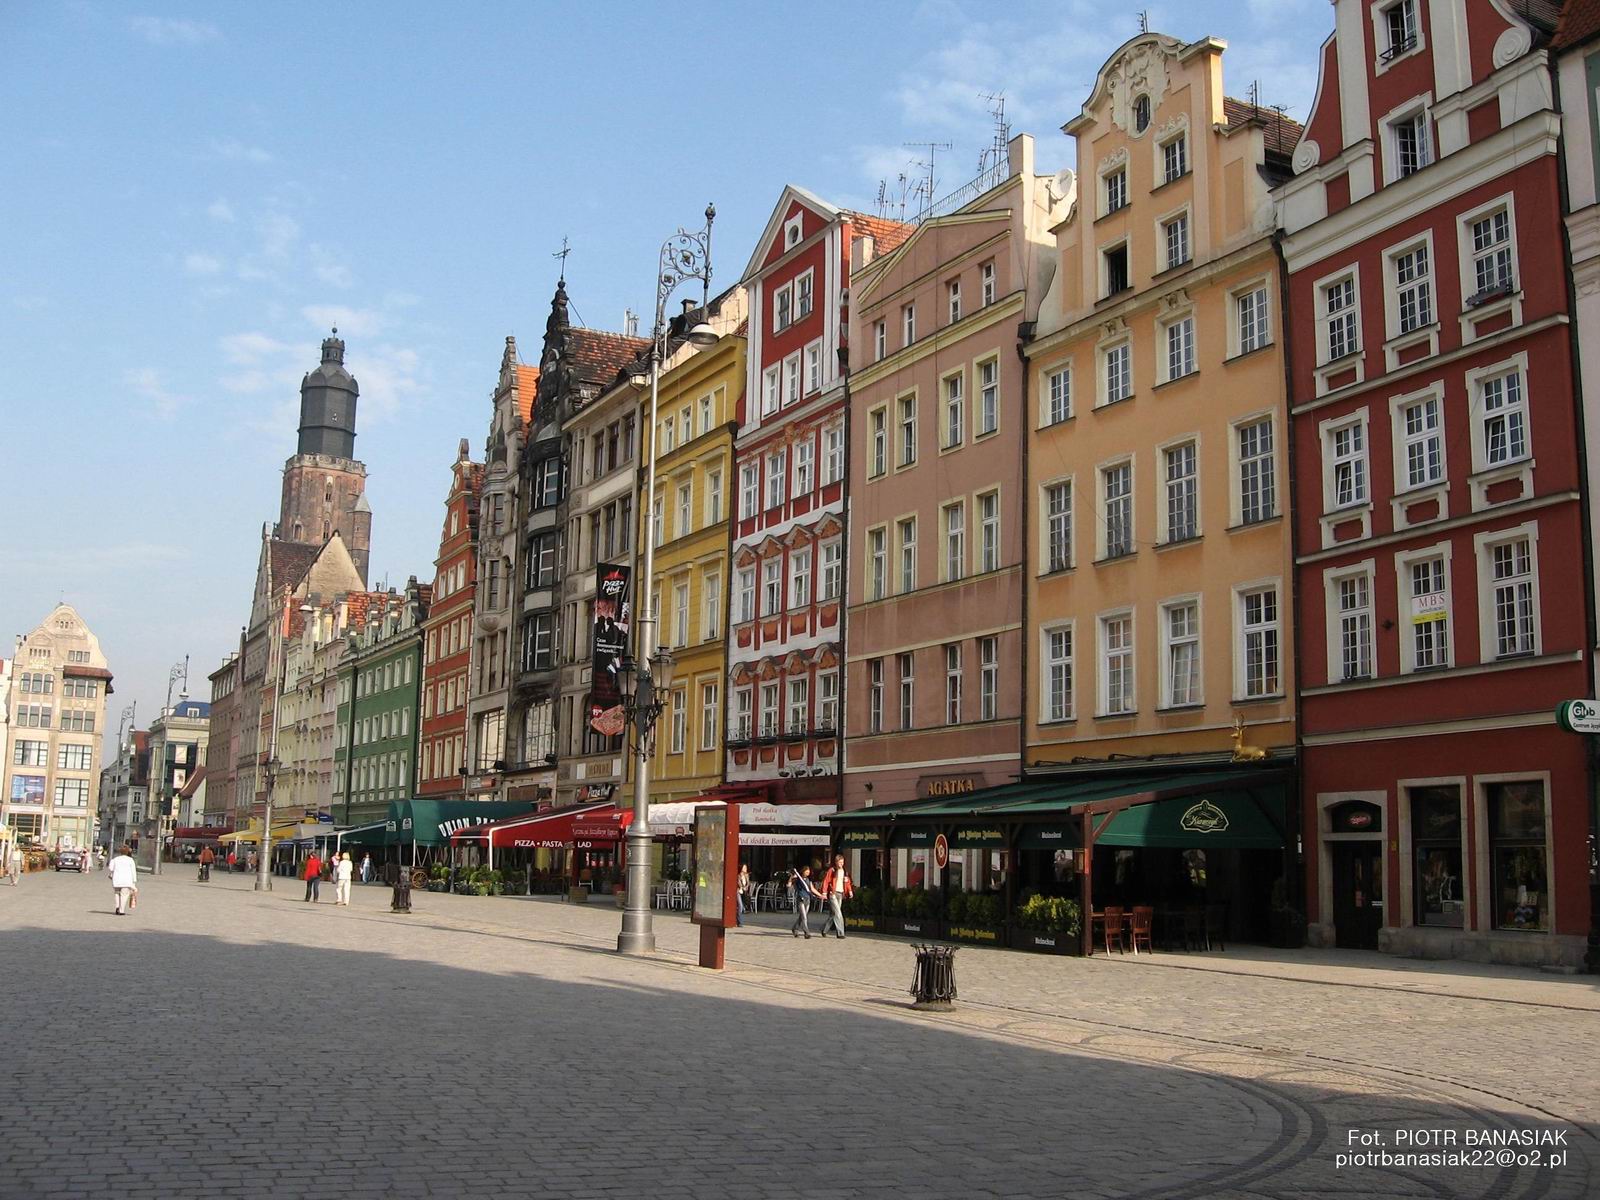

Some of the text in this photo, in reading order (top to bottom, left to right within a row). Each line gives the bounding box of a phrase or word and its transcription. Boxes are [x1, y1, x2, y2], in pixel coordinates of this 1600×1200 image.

[602, 580, 624, 590] Pizza
[606, 586, 620, 594] Hut
[928, 779, 975, 795] AGATKA
[438, 817, 470, 837] UNION
[514, 839, 536, 847] PIZZA
[542, 840, 564, 848] PASTA
